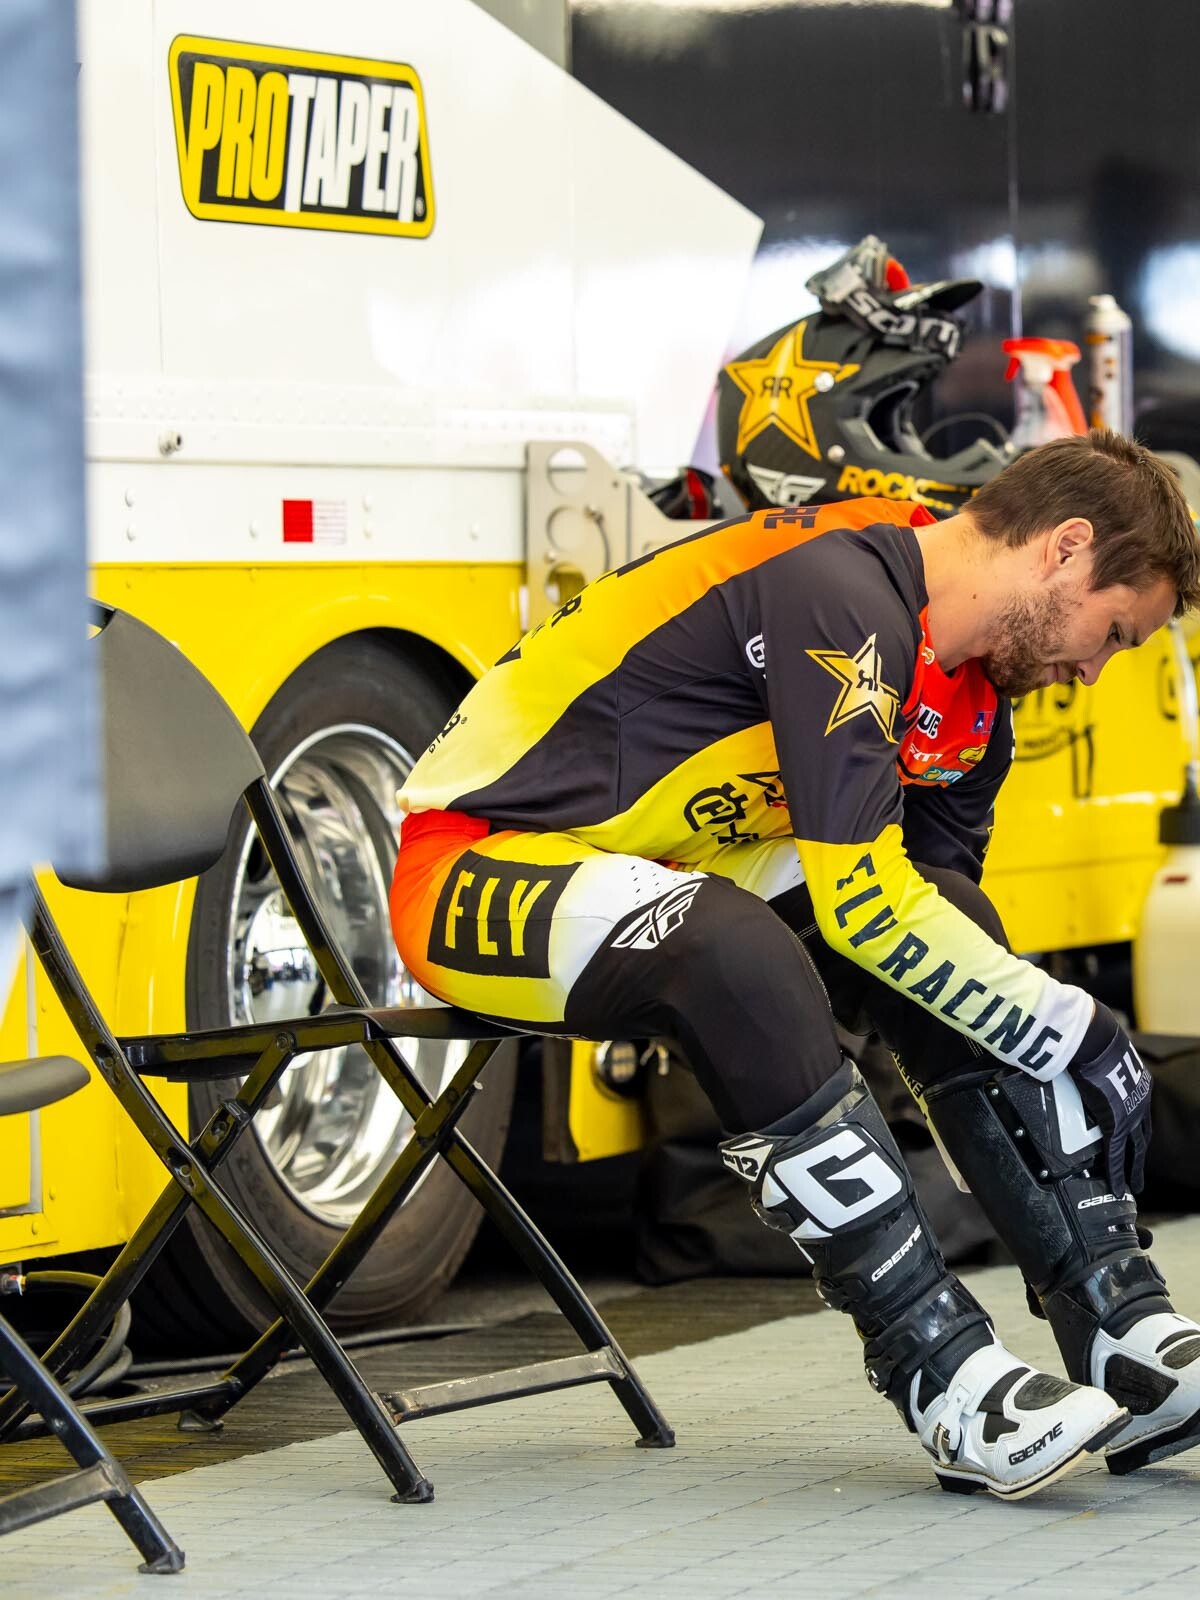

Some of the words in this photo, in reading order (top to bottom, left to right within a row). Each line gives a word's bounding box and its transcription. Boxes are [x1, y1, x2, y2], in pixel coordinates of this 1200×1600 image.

[444, 869, 552, 957] FLY
[834, 853, 898, 949] FLY
[877, 945, 1063, 1072] RACING
[1105, 1040, 1144, 1101] FL
